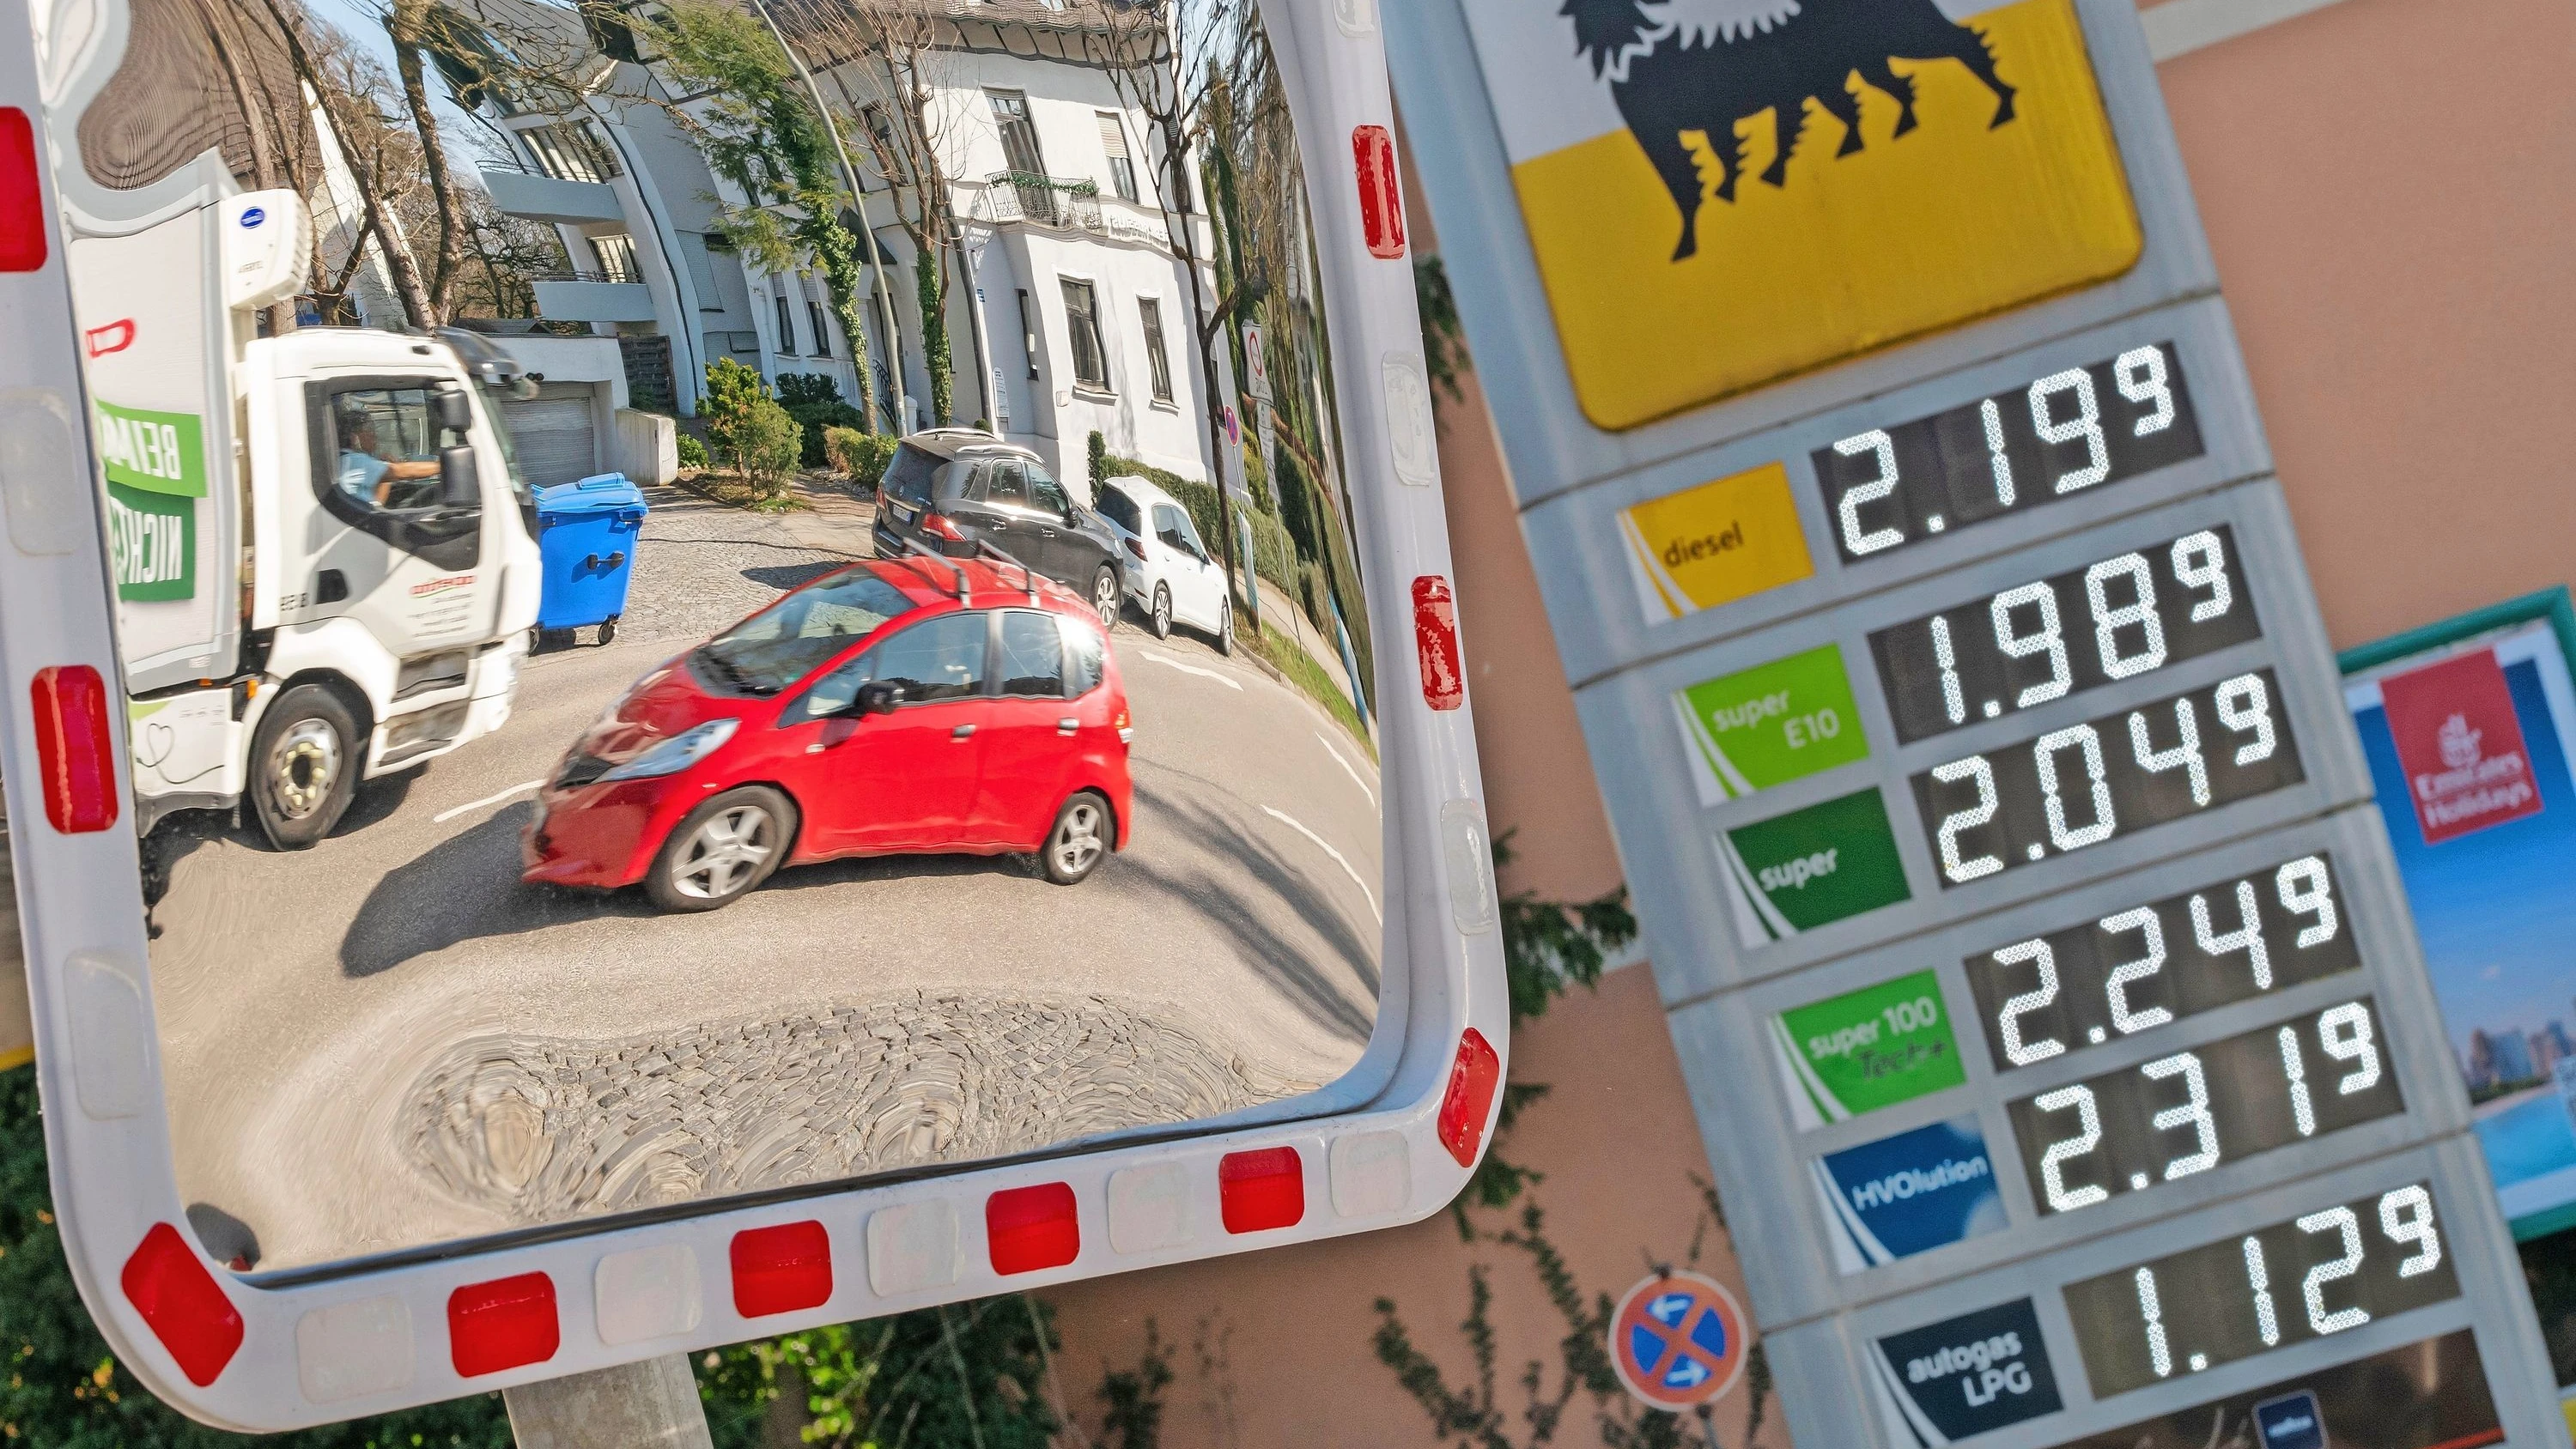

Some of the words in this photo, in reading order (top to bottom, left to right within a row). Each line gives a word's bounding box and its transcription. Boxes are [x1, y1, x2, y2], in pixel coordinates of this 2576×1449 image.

[1832, 343, 2176, 557] 2.199
[1663, 519, 1744, 568] diesel
[1929, 530, 2234, 724] 1.989
[1713, 689, 1790, 732] super
[1782, 707, 1841, 750] E10
[1934, 671, 2278, 884] 2.049
[1759, 847, 1838, 892] super
[1991, 853, 2339, 1067] 2.249
[1808, 1019, 1880, 1060] super
[1882, 996, 1937, 1037] 100
[2033, 1000, 2382, 1213] 2.319
[1852, 1155, 1989, 1211] HVOlution
[2134, 1183, 2443, 1378] 1.129
[1907, 1331, 2022, 1384] autogas
[1962, 1361, 2033, 1408] LPG
